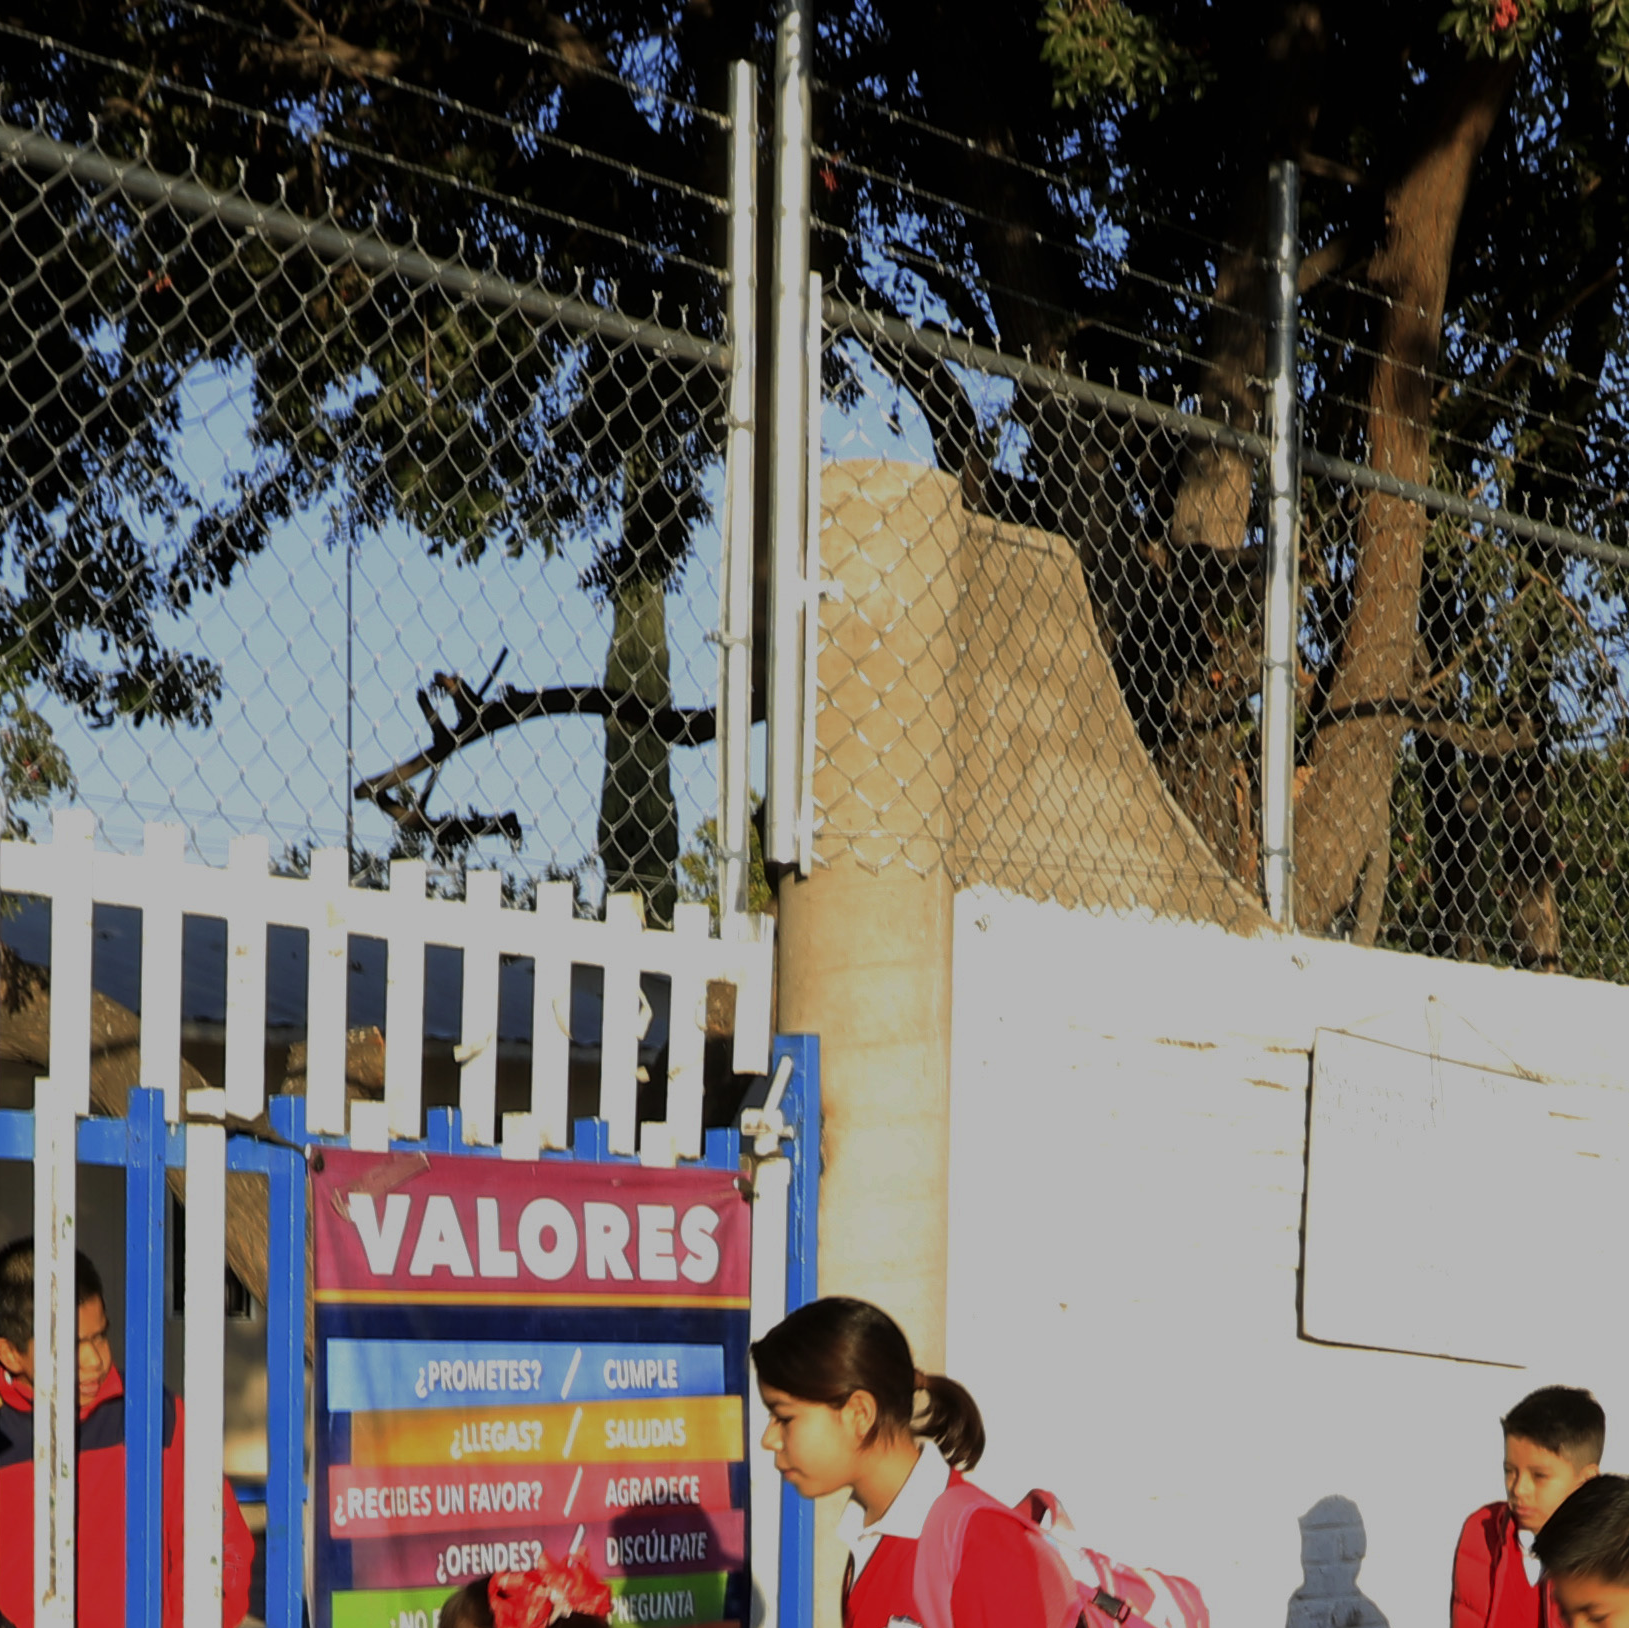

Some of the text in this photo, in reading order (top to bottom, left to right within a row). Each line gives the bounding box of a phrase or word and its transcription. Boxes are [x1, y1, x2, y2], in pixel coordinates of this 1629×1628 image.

[348, 1191, 721, 1285] VALORES
[414, 1359, 543, 1399] ¿PROMETES?
[603, 1358, 679, 1390] CUMPLE
[449, 1420, 544, 1460] ¿LLEGAS?
[603, 1417, 687, 1450] SALUDAS
[333, 1484, 432, 1527] ¿RECIBES
[435, 1483, 465, 1516] UN
[468, 1480, 544, 1513] FAVOR?
[604, 1475, 701, 1509] AGRADECE
[435, 1540, 544, 1585] ¿OFENDES?
[605, 1528, 709, 1568] DISCÚLPATE
